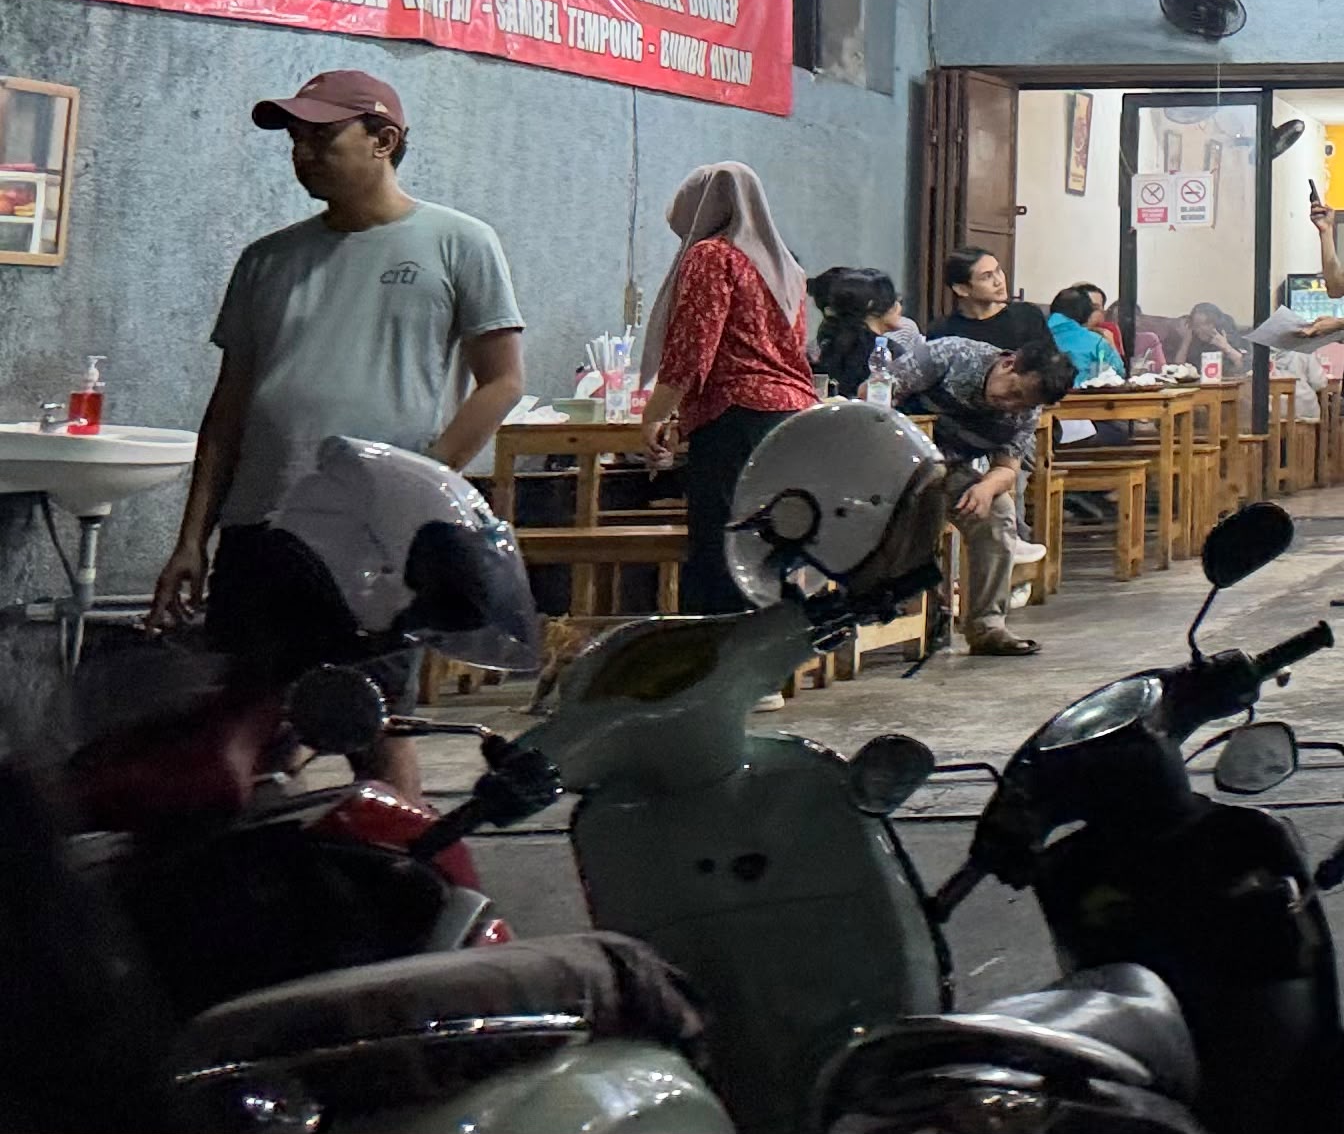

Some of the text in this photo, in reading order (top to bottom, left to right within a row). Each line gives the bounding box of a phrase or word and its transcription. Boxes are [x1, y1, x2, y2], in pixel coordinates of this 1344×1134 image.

[565, 7, 644, 63] TEMPONG
[660, 29, 708, 78] BUMBU
[709, 42, 753, 86] HITAM
